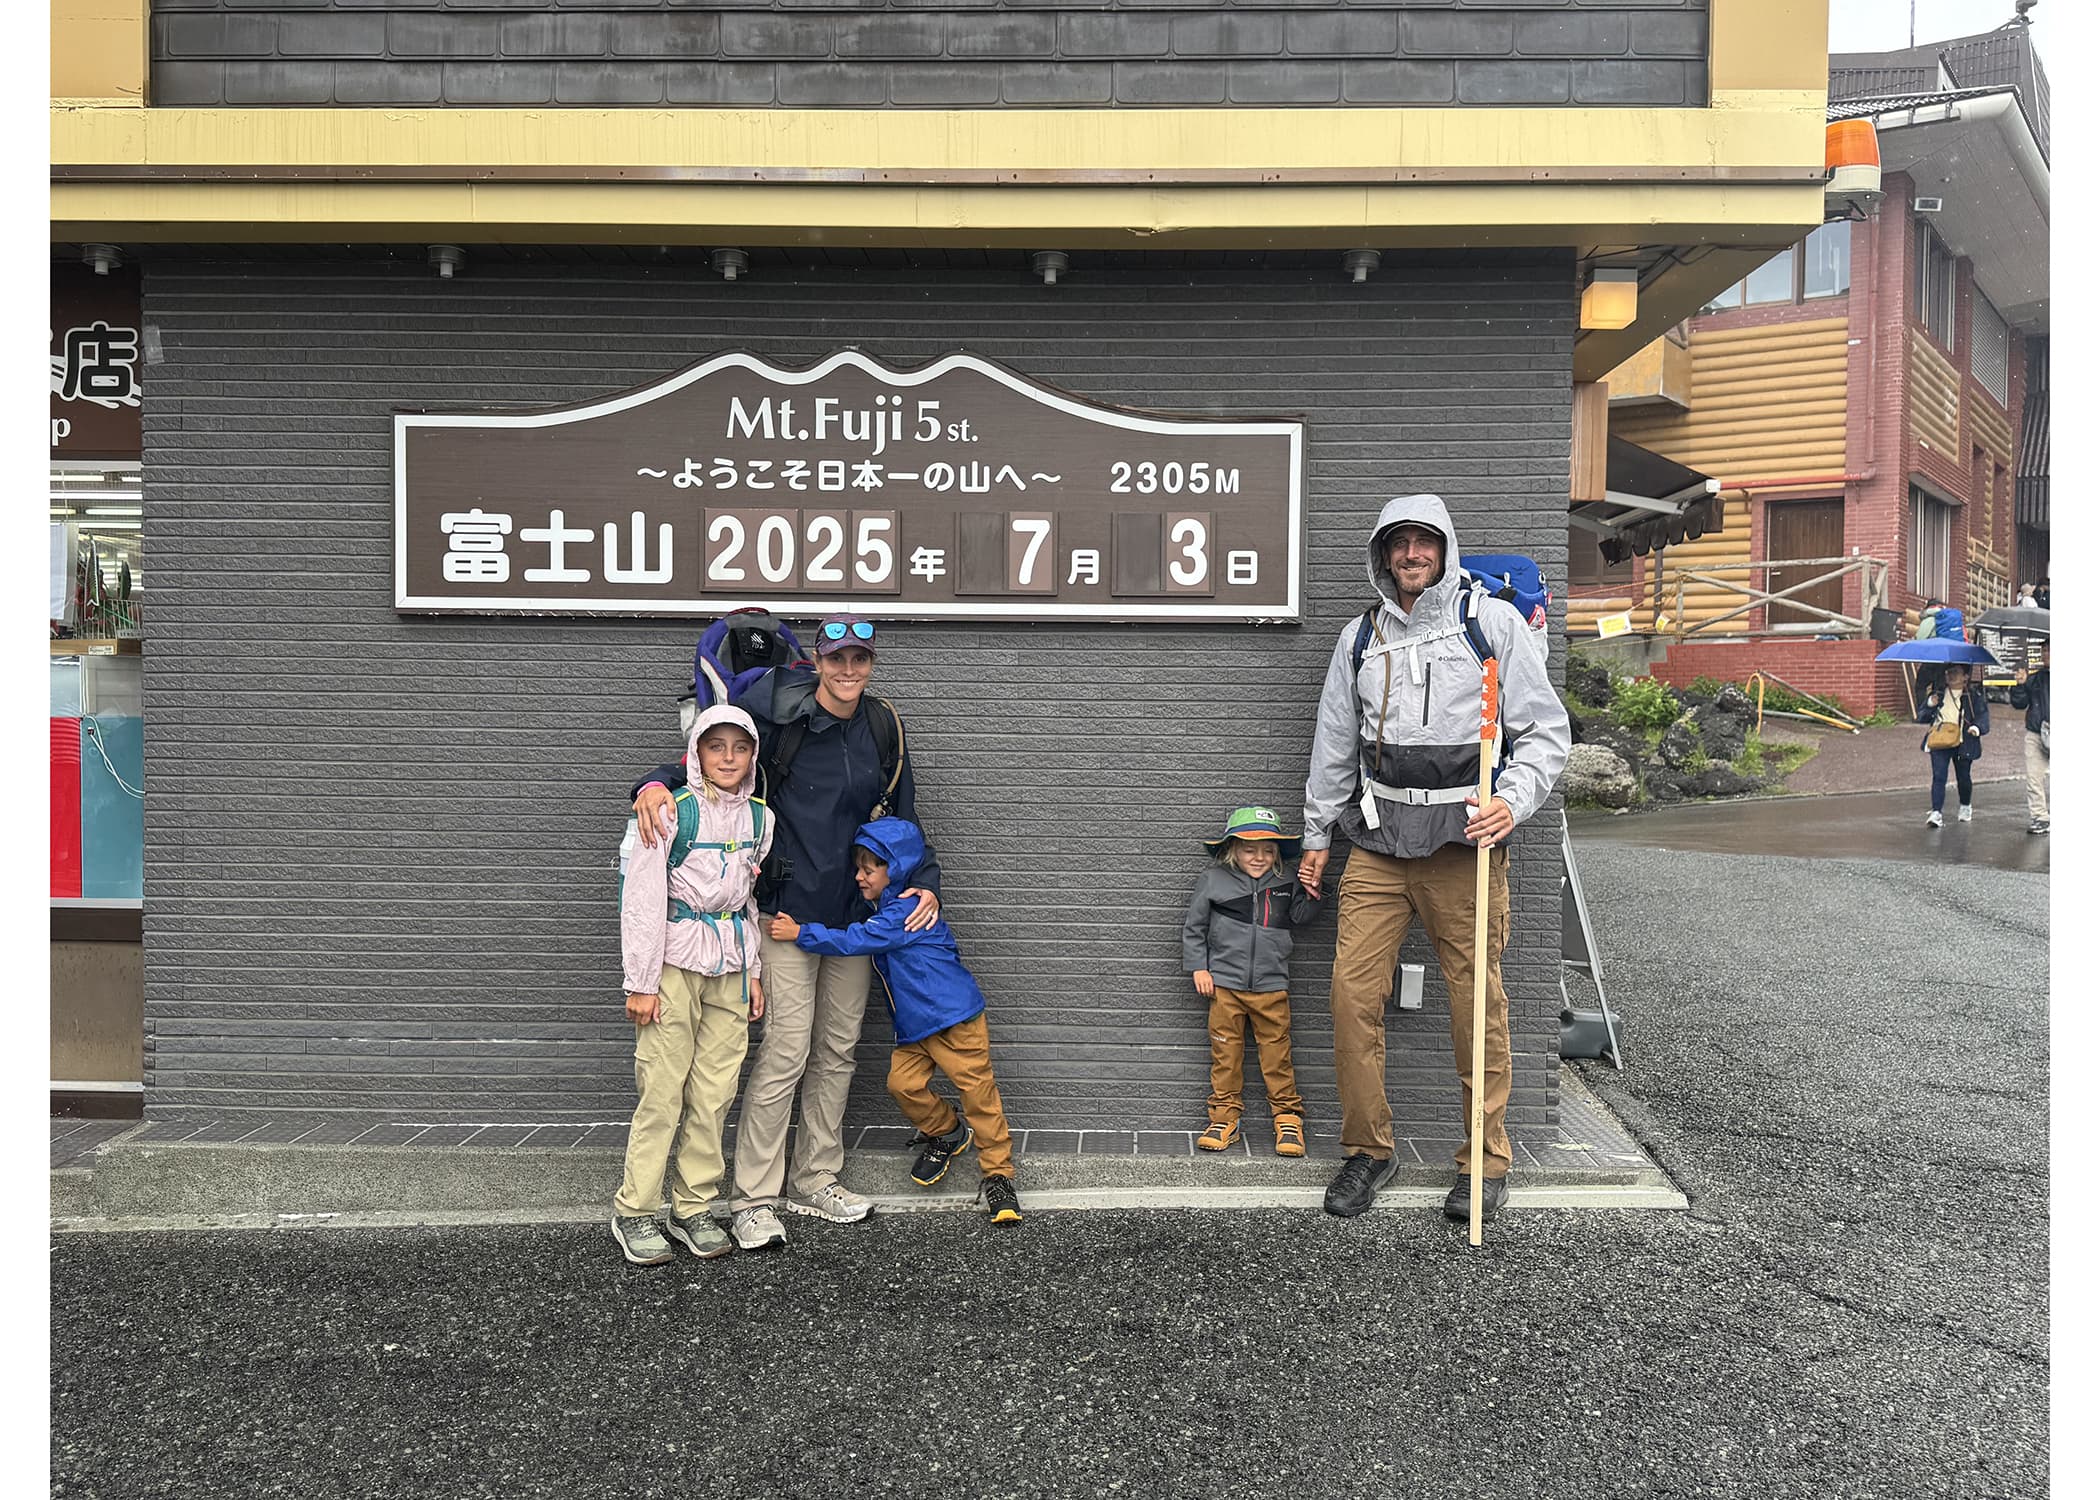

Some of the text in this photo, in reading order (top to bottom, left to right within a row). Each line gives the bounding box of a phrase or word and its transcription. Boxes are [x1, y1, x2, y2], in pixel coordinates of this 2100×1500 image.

[726, 394, 903, 456] Mt.Fuji
[1110, 461, 1240, 494] 2305M
[440, 508, 673, 584] 富士山
